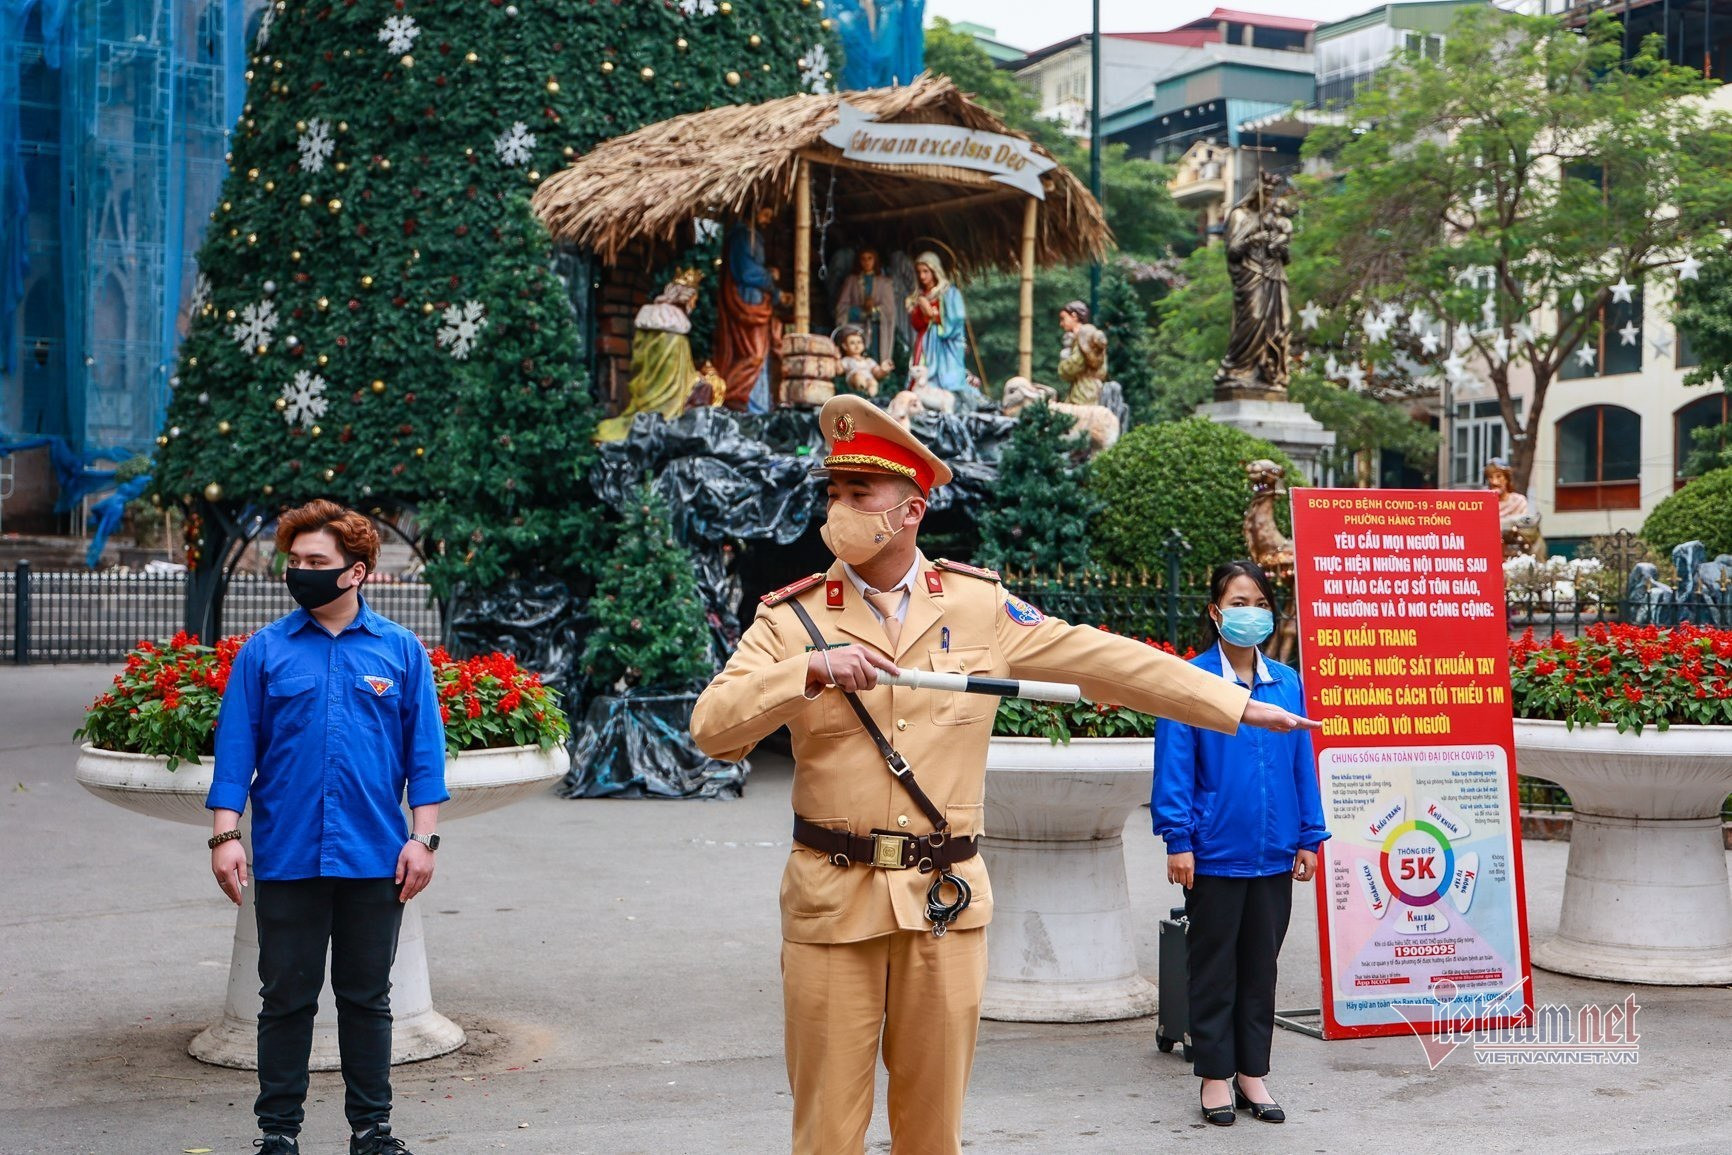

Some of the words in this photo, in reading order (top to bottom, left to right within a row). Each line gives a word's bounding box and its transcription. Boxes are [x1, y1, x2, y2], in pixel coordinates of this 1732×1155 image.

[851, 129, 897, 152] Gloria
[900, 136, 917, 153] in
[920, 136, 992, 161] excelsis
[994, 144, 1028, 172] Deo
[1308, 499, 1330, 508] BCĐ
[1356, 497, 1382, 510] BỆNH
[1385, 500, 1428, 510] COVID-19
[1436, 500, 1456, 510] BAN
[1458, 501, 1484, 511] QLDT
[1344, 514, 1385, 525] PHƯỜNG
[1388, 514, 1415, 525] HÀNG
[1418, 513, 1451, 526] TRỐNG
[1334, 532, 1354, 549] YÊU
[1358, 530, 1379, 549] CẦU
[1383, 535, 1404, 552] MỌI
[1406, 531, 1439, 550] NGƯỜI
[1442, 532, 1464, 550] DÂN
[1313, 556, 1342, 575] THỰC
[1345, 554, 1370, 575] HIỆN
[1373, 554, 1410, 572] NHỮNG
[1413, 555, 1432, 575] NỘI
[1435, 558, 1464, 572] DUNG
[1467, 557, 1487, 572] SAU
[1324, 580, 1342, 594] KHI
[1345, 577, 1366, 594] VÀO
[1370, 577, 1391, 594] CÁC
[1394, 579, 1409, 594] CƠ
[1412, 576, 1426, 594] SỞ
[1428, 577, 1450, 594] TÔN
[1452, 577, 1480, 596] GIÁO,
[1312, 599, 1330, 617] TÍN
[1333, 599, 1378, 617] NGƯỠNG
[1381, 600, 1395, 617] VÀ
[1398, 598, 1405, 617] Ở
[1408, 601, 1427, 617] NƠI
[1430, 600, 1459, 617] CÔNG
[1462, 600, 1494, 620] CỘNG:
[1317, 629, 1340, 646] ĐEO
[1344, 622, 1376, 646] KHẨU
[1379, 629, 1417, 646] TRANG
[1319, 653, 1337, 676] SỬ
[1339, 659, 1371, 680] DỤNG
[1374, 655, 1406, 676] NƯỚC
[1409, 655, 1431, 675] SÁT
[1434, 651, 1474, 675] KHUẨN
[1476, 658, 1495, 675] TAY
[1321, 685, 1342, 706] GIỮ
[1344, 682, 1393, 705] KHOẢNG
[1396, 684, 1427, 704] CÁCH
[1430, 681, 1448, 704] TỐI
[1450, 680, 1483, 704] THIỂU
[1486, 686, 1504, 703] 1M
[1321, 714, 1350, 736] GIỮA
[1353, 713, 1389, 735] NGƯỜI
[1392, 714, 1411, 734] VỚI
[1414, 712, 1450, 734] NGƯỜI
[1332, 754, 1358, 763] CHUNG
[1360, 751, 1379, 762] SỐNG
[1382, 753, 1392, 762] AN
[1394, 750, 1412, 762] TOÀN
[1414, 751, 1426, 761] VỚI
[1429, 752, 1440, 763] ĐẠI
[1443, 752, 1459, 763] DỊCH
[1462, 751, 1495, 760] COVID-19
[1385, 804, 1402, 821] TRANG
[1441, 818, 1458, 834] KHUẨN
[1421, 846, 1435, 855] ĐIỆP
[1400, 856, 1436, 880] 5K
[1407, 911, 1423, 922] KHAI
[1395, 945, 1454, 956] 19009095
[1346, 1002, 1357, 1011] Hãy
[1358, 1001, 1368, 1010] giữ
